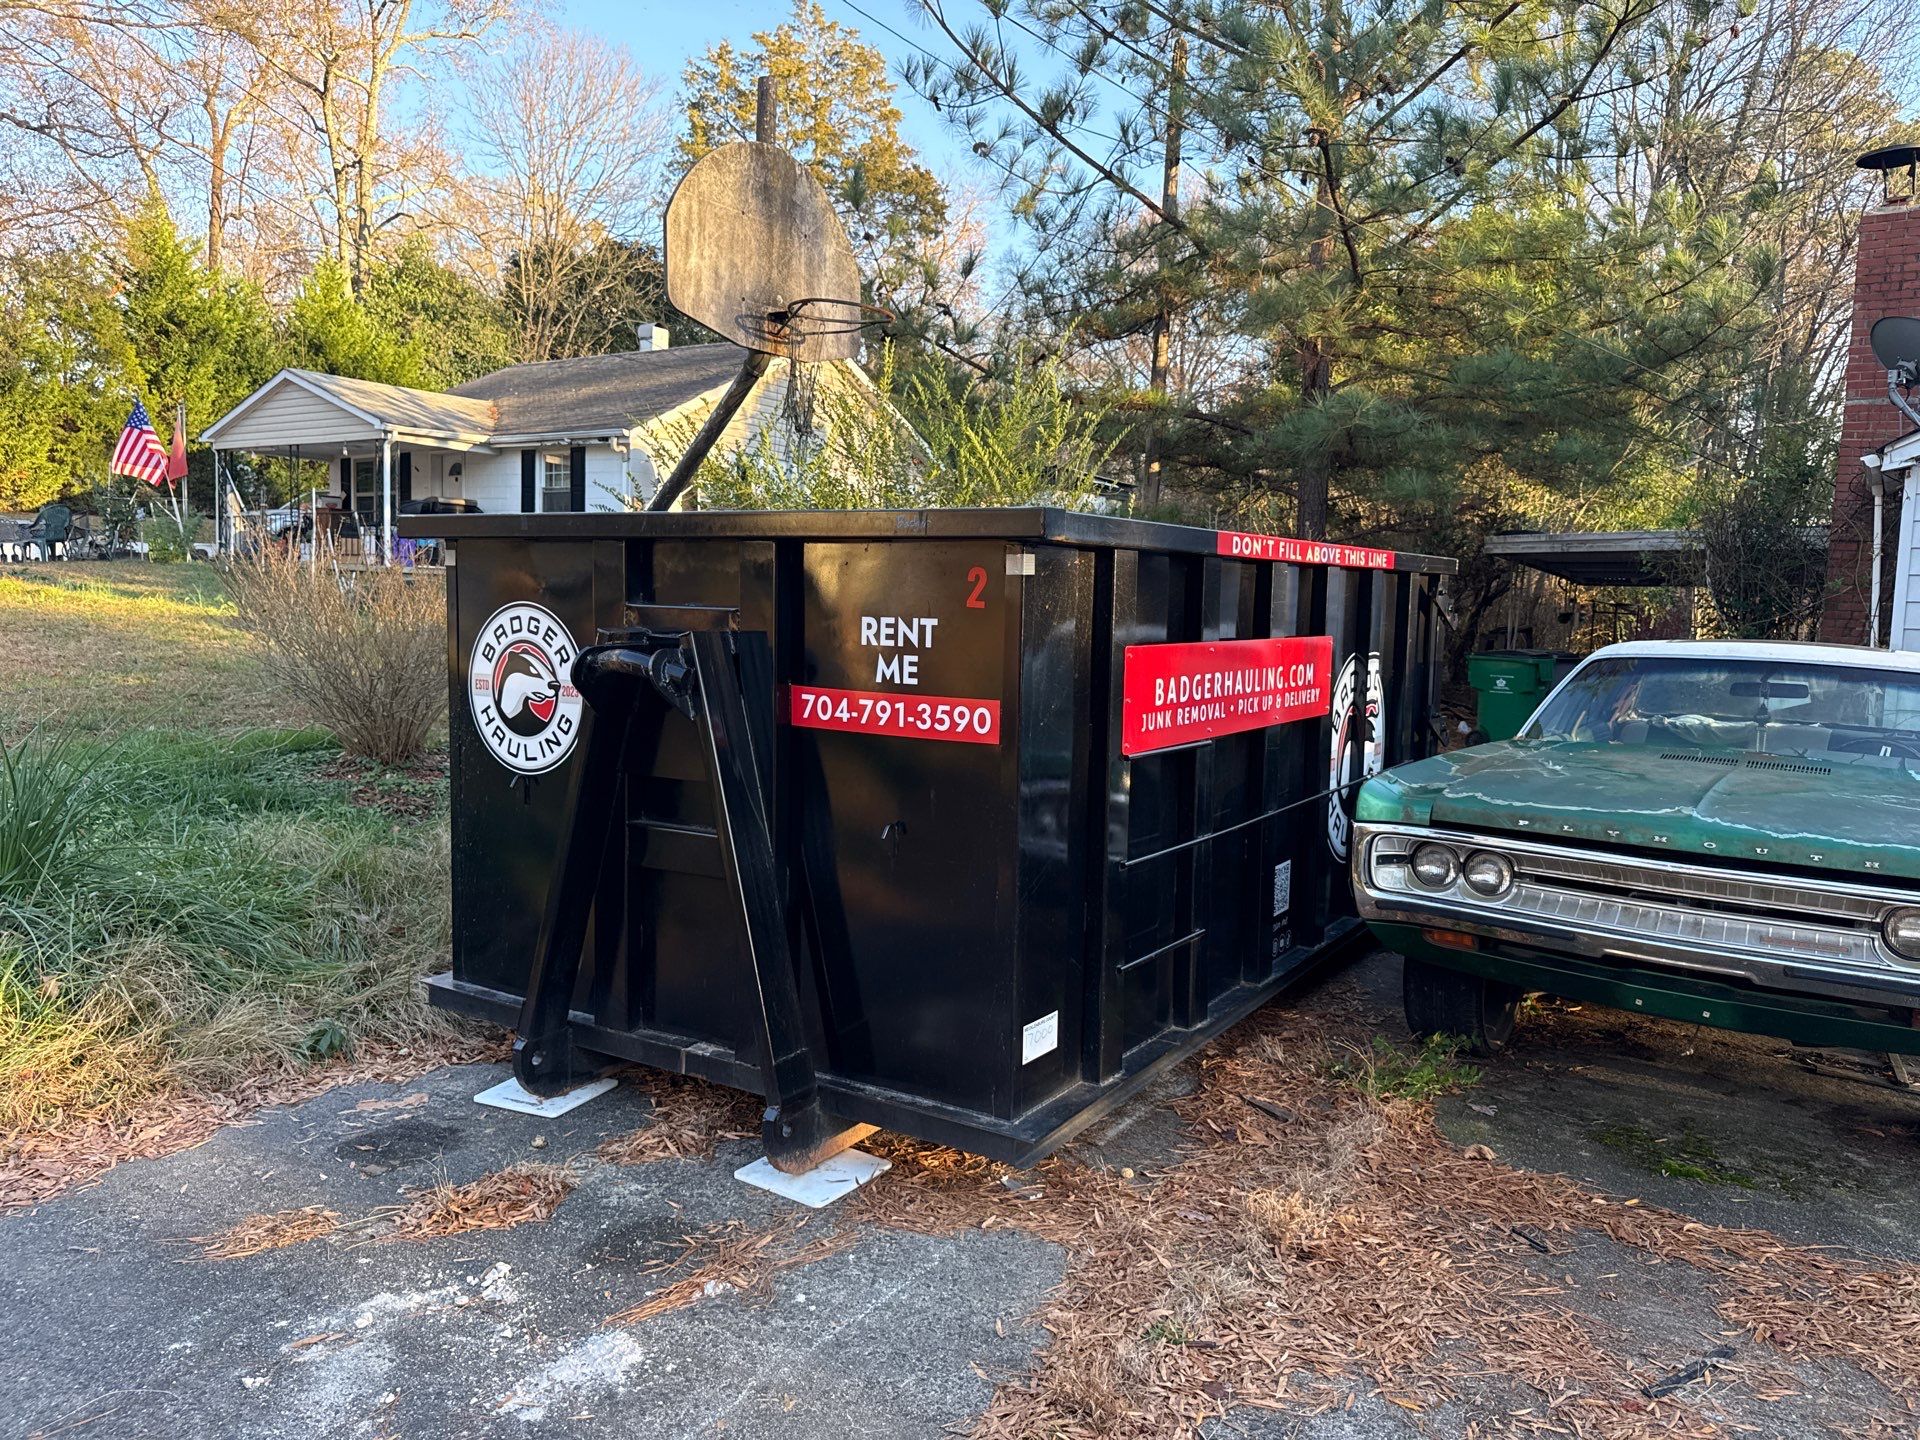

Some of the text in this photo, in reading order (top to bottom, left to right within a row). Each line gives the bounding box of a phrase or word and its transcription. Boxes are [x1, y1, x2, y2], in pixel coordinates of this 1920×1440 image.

[1232, 535, 1388, 568] DON'T FILL ABOVE THIS LINE
[966, 566, 988, 609] 2
[481, 615, 571, 667] BADGER
[860, 616, 939, 649] RENT
[475, 679, 490, 691] ESTD
[875, 652, 919, 685] ME
[1154, 662, 1315, 707] BADGERHAULING.COM
[801, 693, 992, 735] 704-791-3590
[1141, 687, 1321, 732] JUNK REMOVAL PICK UP & DELIVERY
[480, 705, 573, 762] HAULING
[1517, 819, 1880, 869] PLYMOUTH
